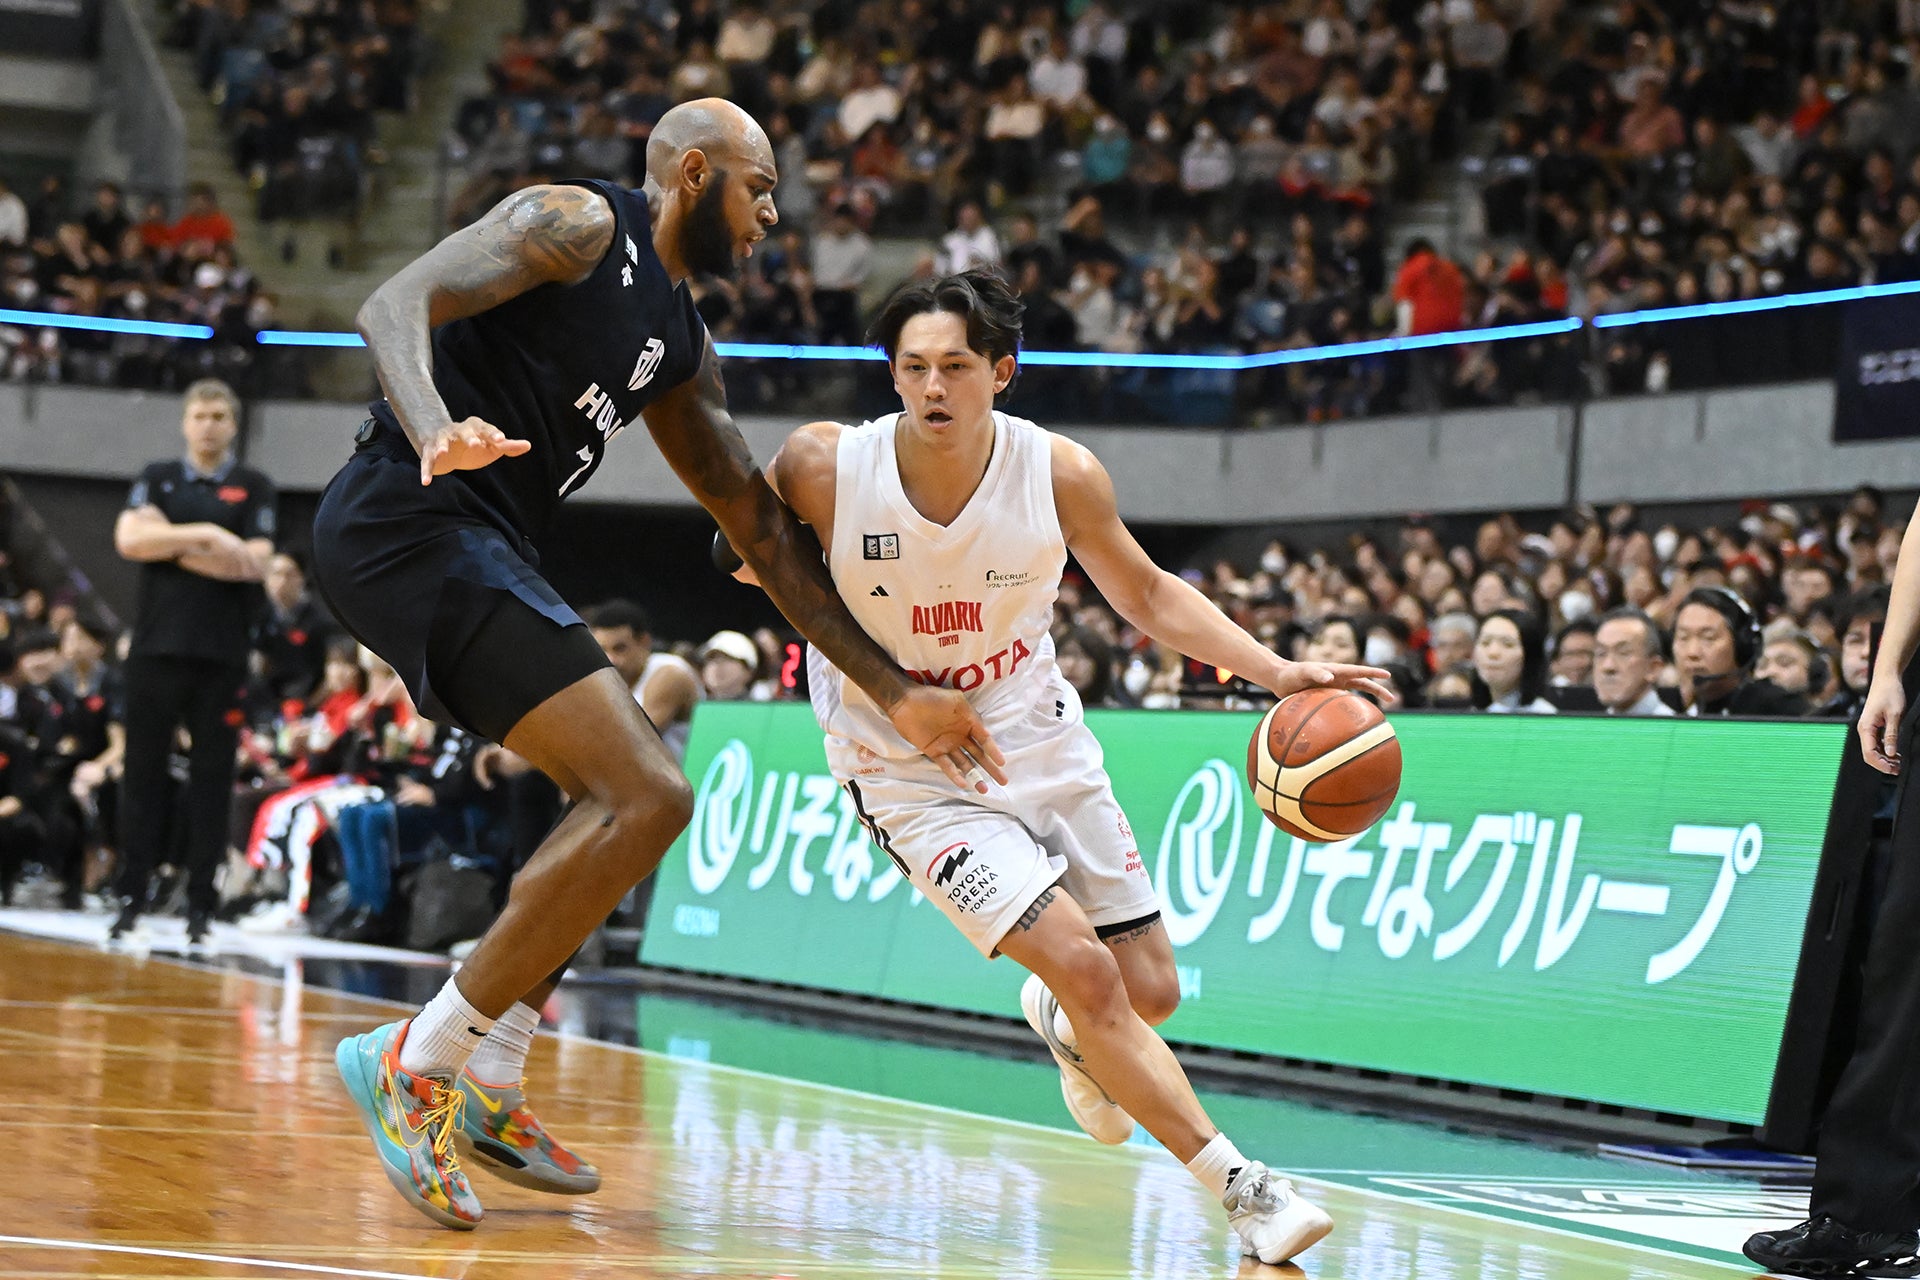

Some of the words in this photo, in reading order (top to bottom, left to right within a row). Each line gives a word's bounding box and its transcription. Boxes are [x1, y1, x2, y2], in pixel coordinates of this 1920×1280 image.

[558, 444, 595, 497] 7
[987, 570, 1029, 581] RECRUIT
[912, 601, 984, 635] ALVARK
[938, 634, 960, 648] TOKYO
[904, 638, 1030, 693] YOTA
[947, 864, 990, 903] TOYOTA
[956, 871, 998, 913] ARENA
[969, 886, 997, 914] TOKYO
[1247, 801, 1763, 985] りそなグループ
